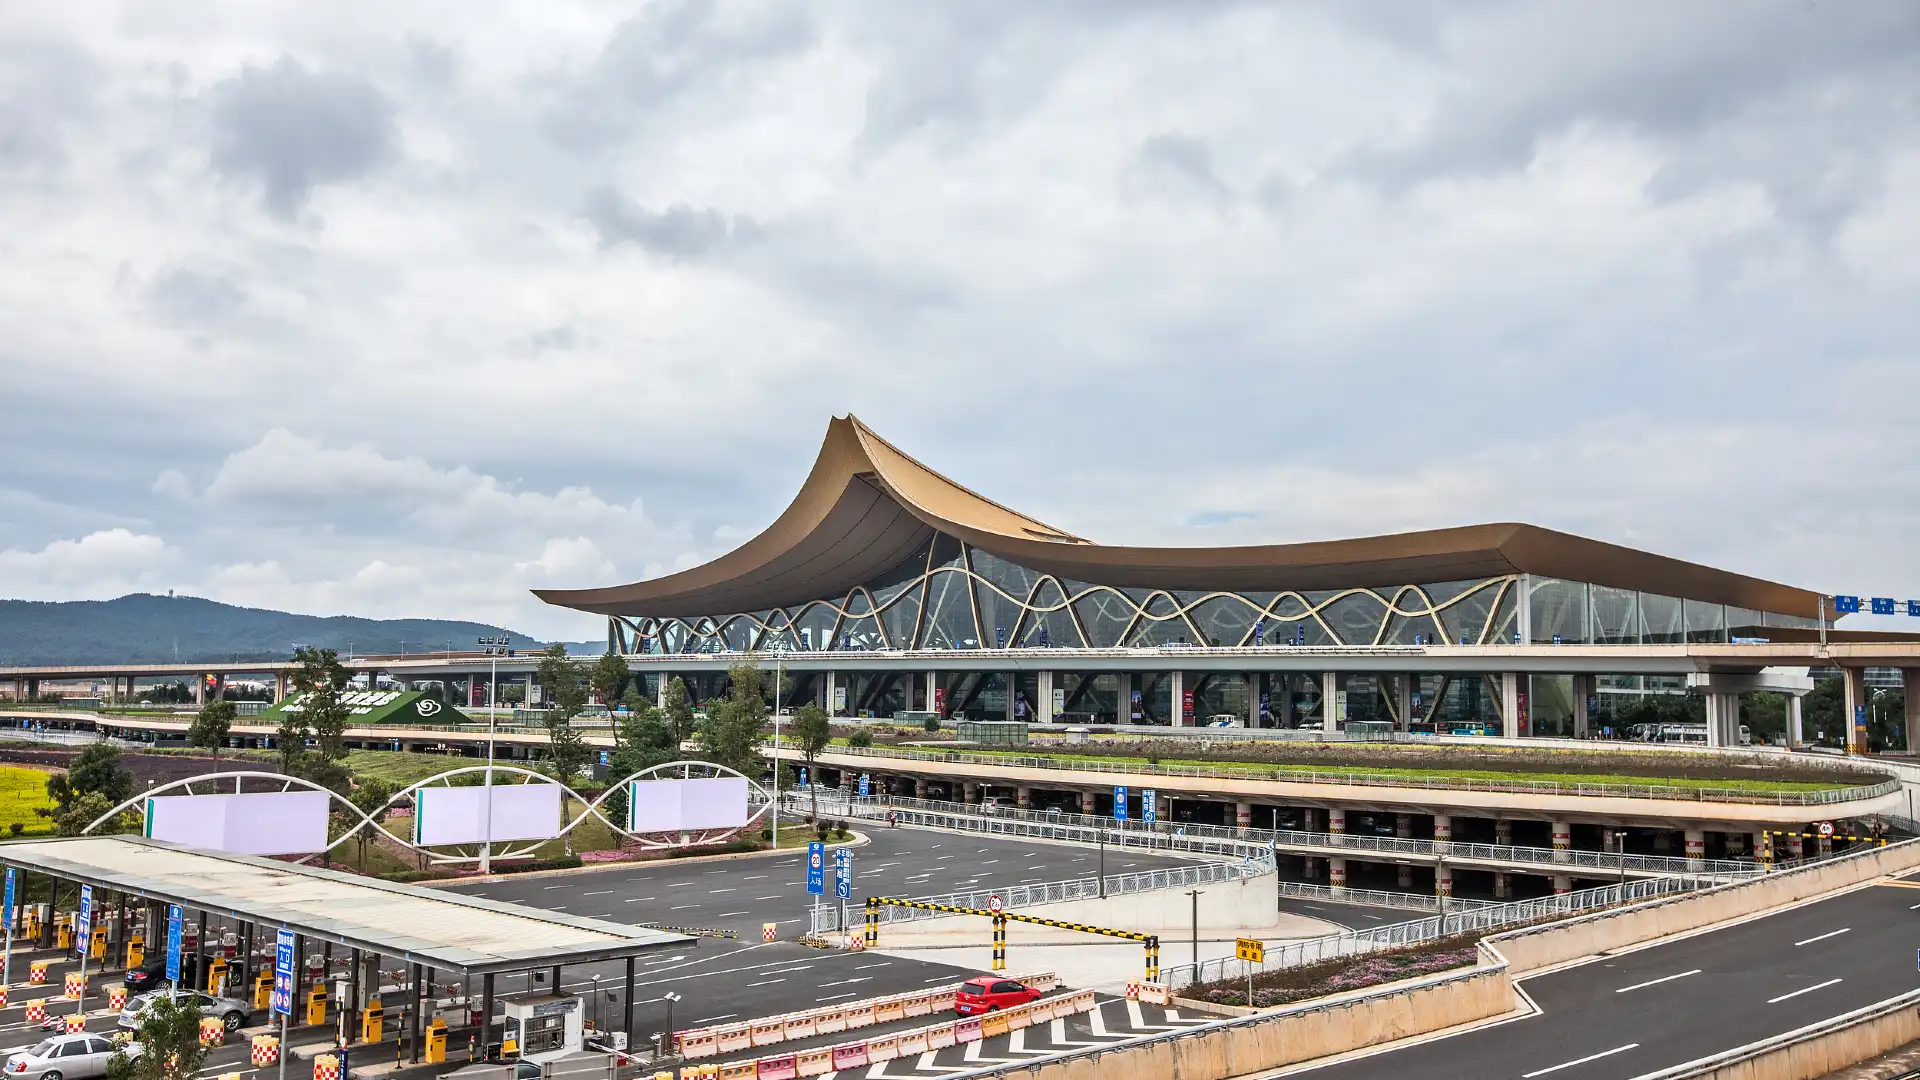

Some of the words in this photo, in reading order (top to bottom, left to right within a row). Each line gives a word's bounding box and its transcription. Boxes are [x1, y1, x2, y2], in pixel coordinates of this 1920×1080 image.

[812, 856, 820, 865] 20
[810, 877, 822, 886] 入场
[1237, 941, 1261, 951] 消防专用
[280, 952, 289, 962] 入口
[1241, 950, 1257, 959] 通道
